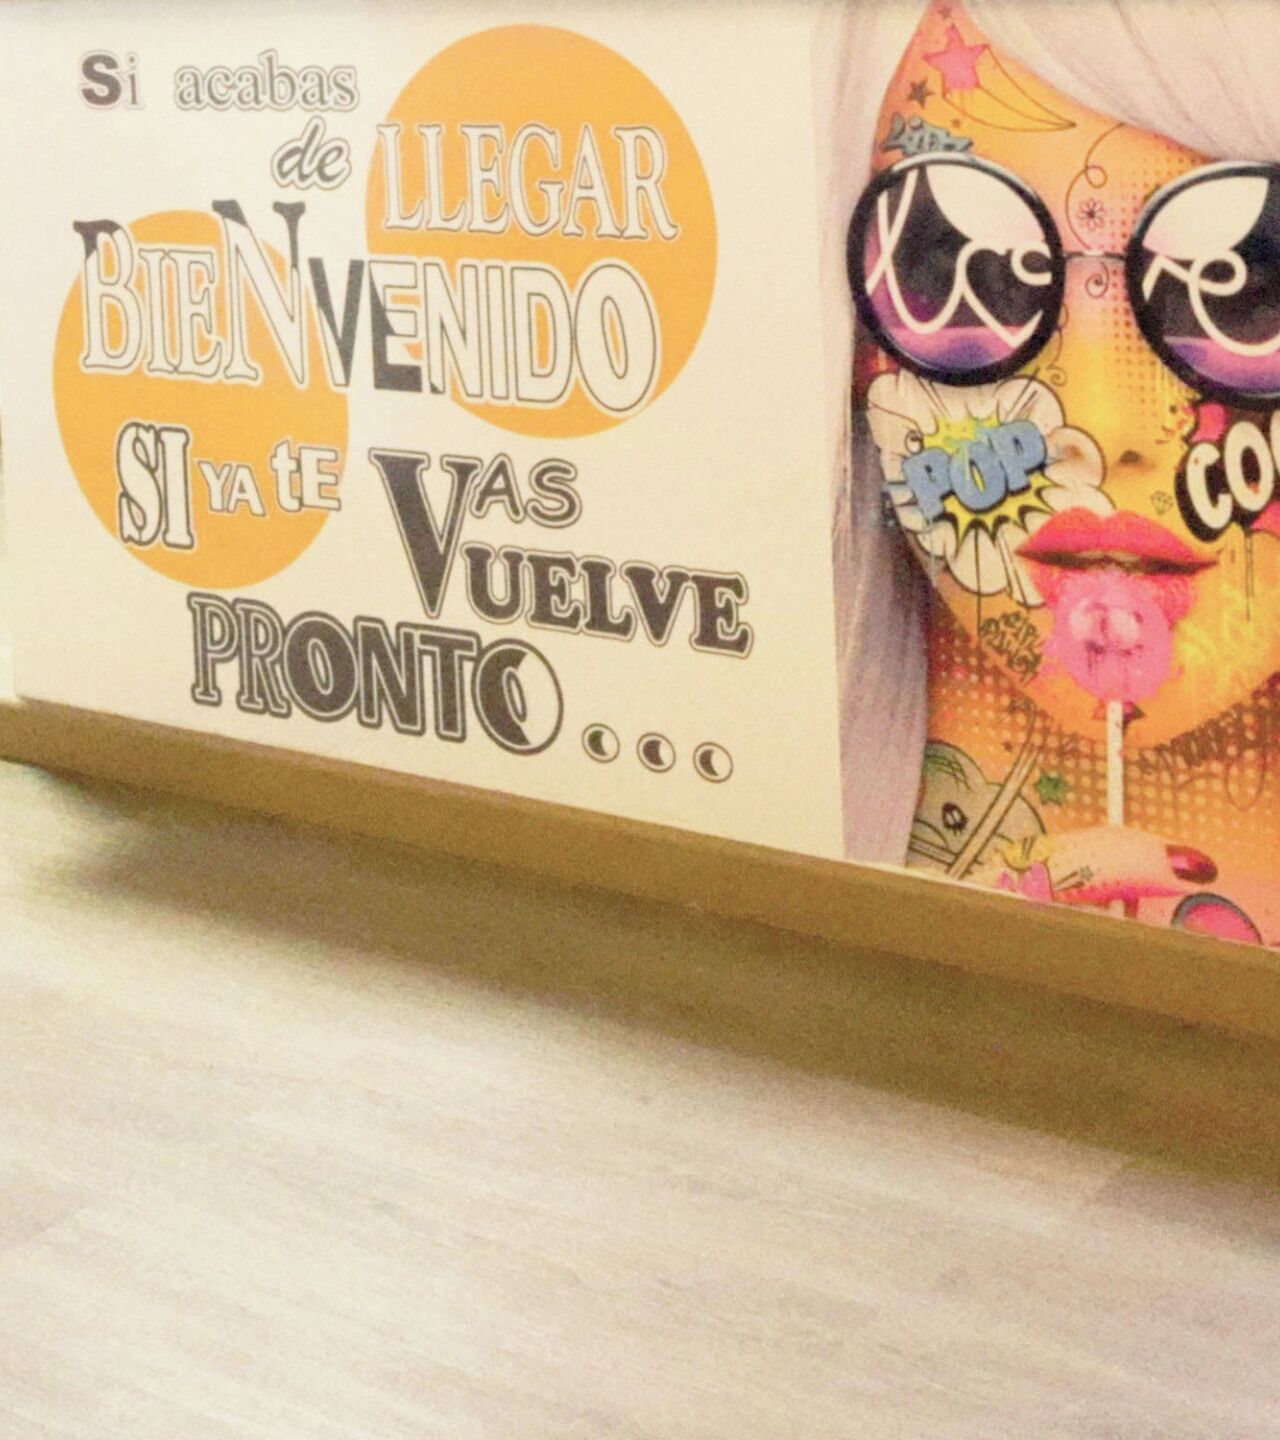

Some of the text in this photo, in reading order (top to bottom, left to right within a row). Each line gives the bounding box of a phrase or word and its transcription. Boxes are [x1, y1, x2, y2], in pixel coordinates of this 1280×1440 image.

[80, 50, 359, 113] Si acabas
[270, 116, 683, 242] de LLEGAR
[72, 199, 661, 416] BIENVENIDO
[114, 420, 195, 550] SI
[197, 458, 266, 519] YA
[901, 418, 1048, 523] POP
